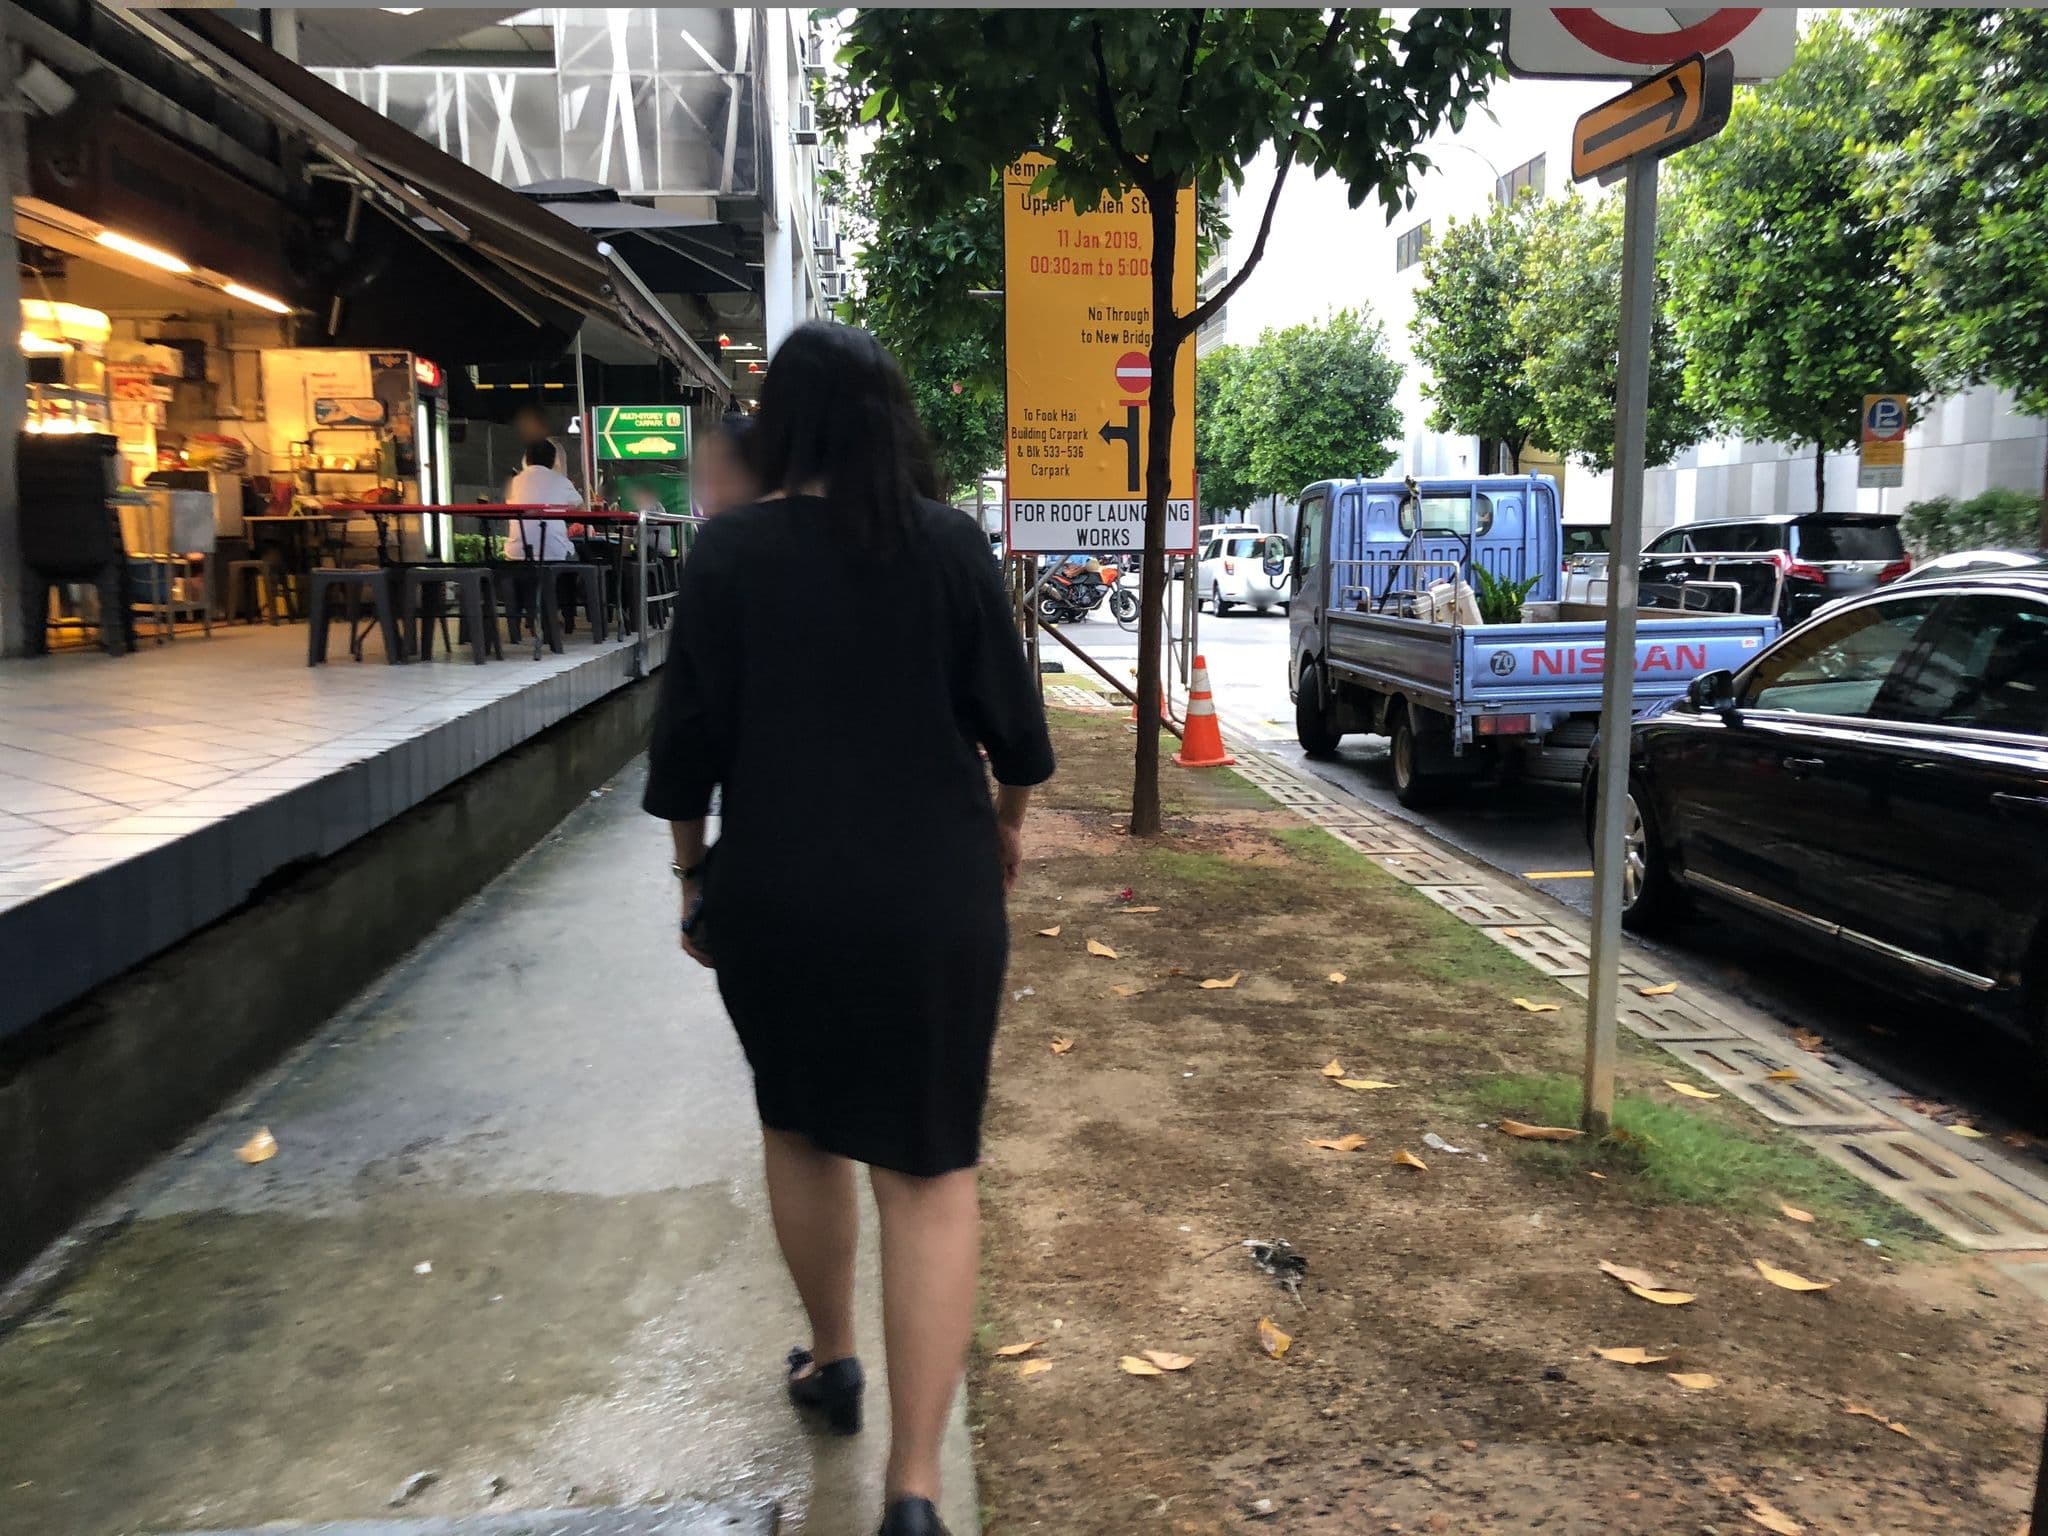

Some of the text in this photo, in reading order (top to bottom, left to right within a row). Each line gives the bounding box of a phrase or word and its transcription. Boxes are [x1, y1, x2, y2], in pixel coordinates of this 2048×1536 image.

[1021, 193, 1065, 216] Upper
[1131, 196, 1179, 214] Stt
[1057, 230, 1069, 247] 11
[1074, 230, 1100, 248] Jan
[1030, 256, 1093, 275] 00:30am
[1099, 258, 1113, 275] to
[1088, 306, 1150, 325] No Through
[1081, 330, 1151, 347] to New Bridg
[1023, 408, 1077, 422] To Fook Hai
[1011, 427, 1089, 443] Building Carpark
[1017, 446, 1084, 458] & Blk 533-536
[1031, 464, 1070, 479] Carpark
[1015, 503, 1190, 522] FOR ROOF LAUNCNG
[1077, 528, 1130, 546] WORKS
[1531, 644, 1707, 676] NISAN
